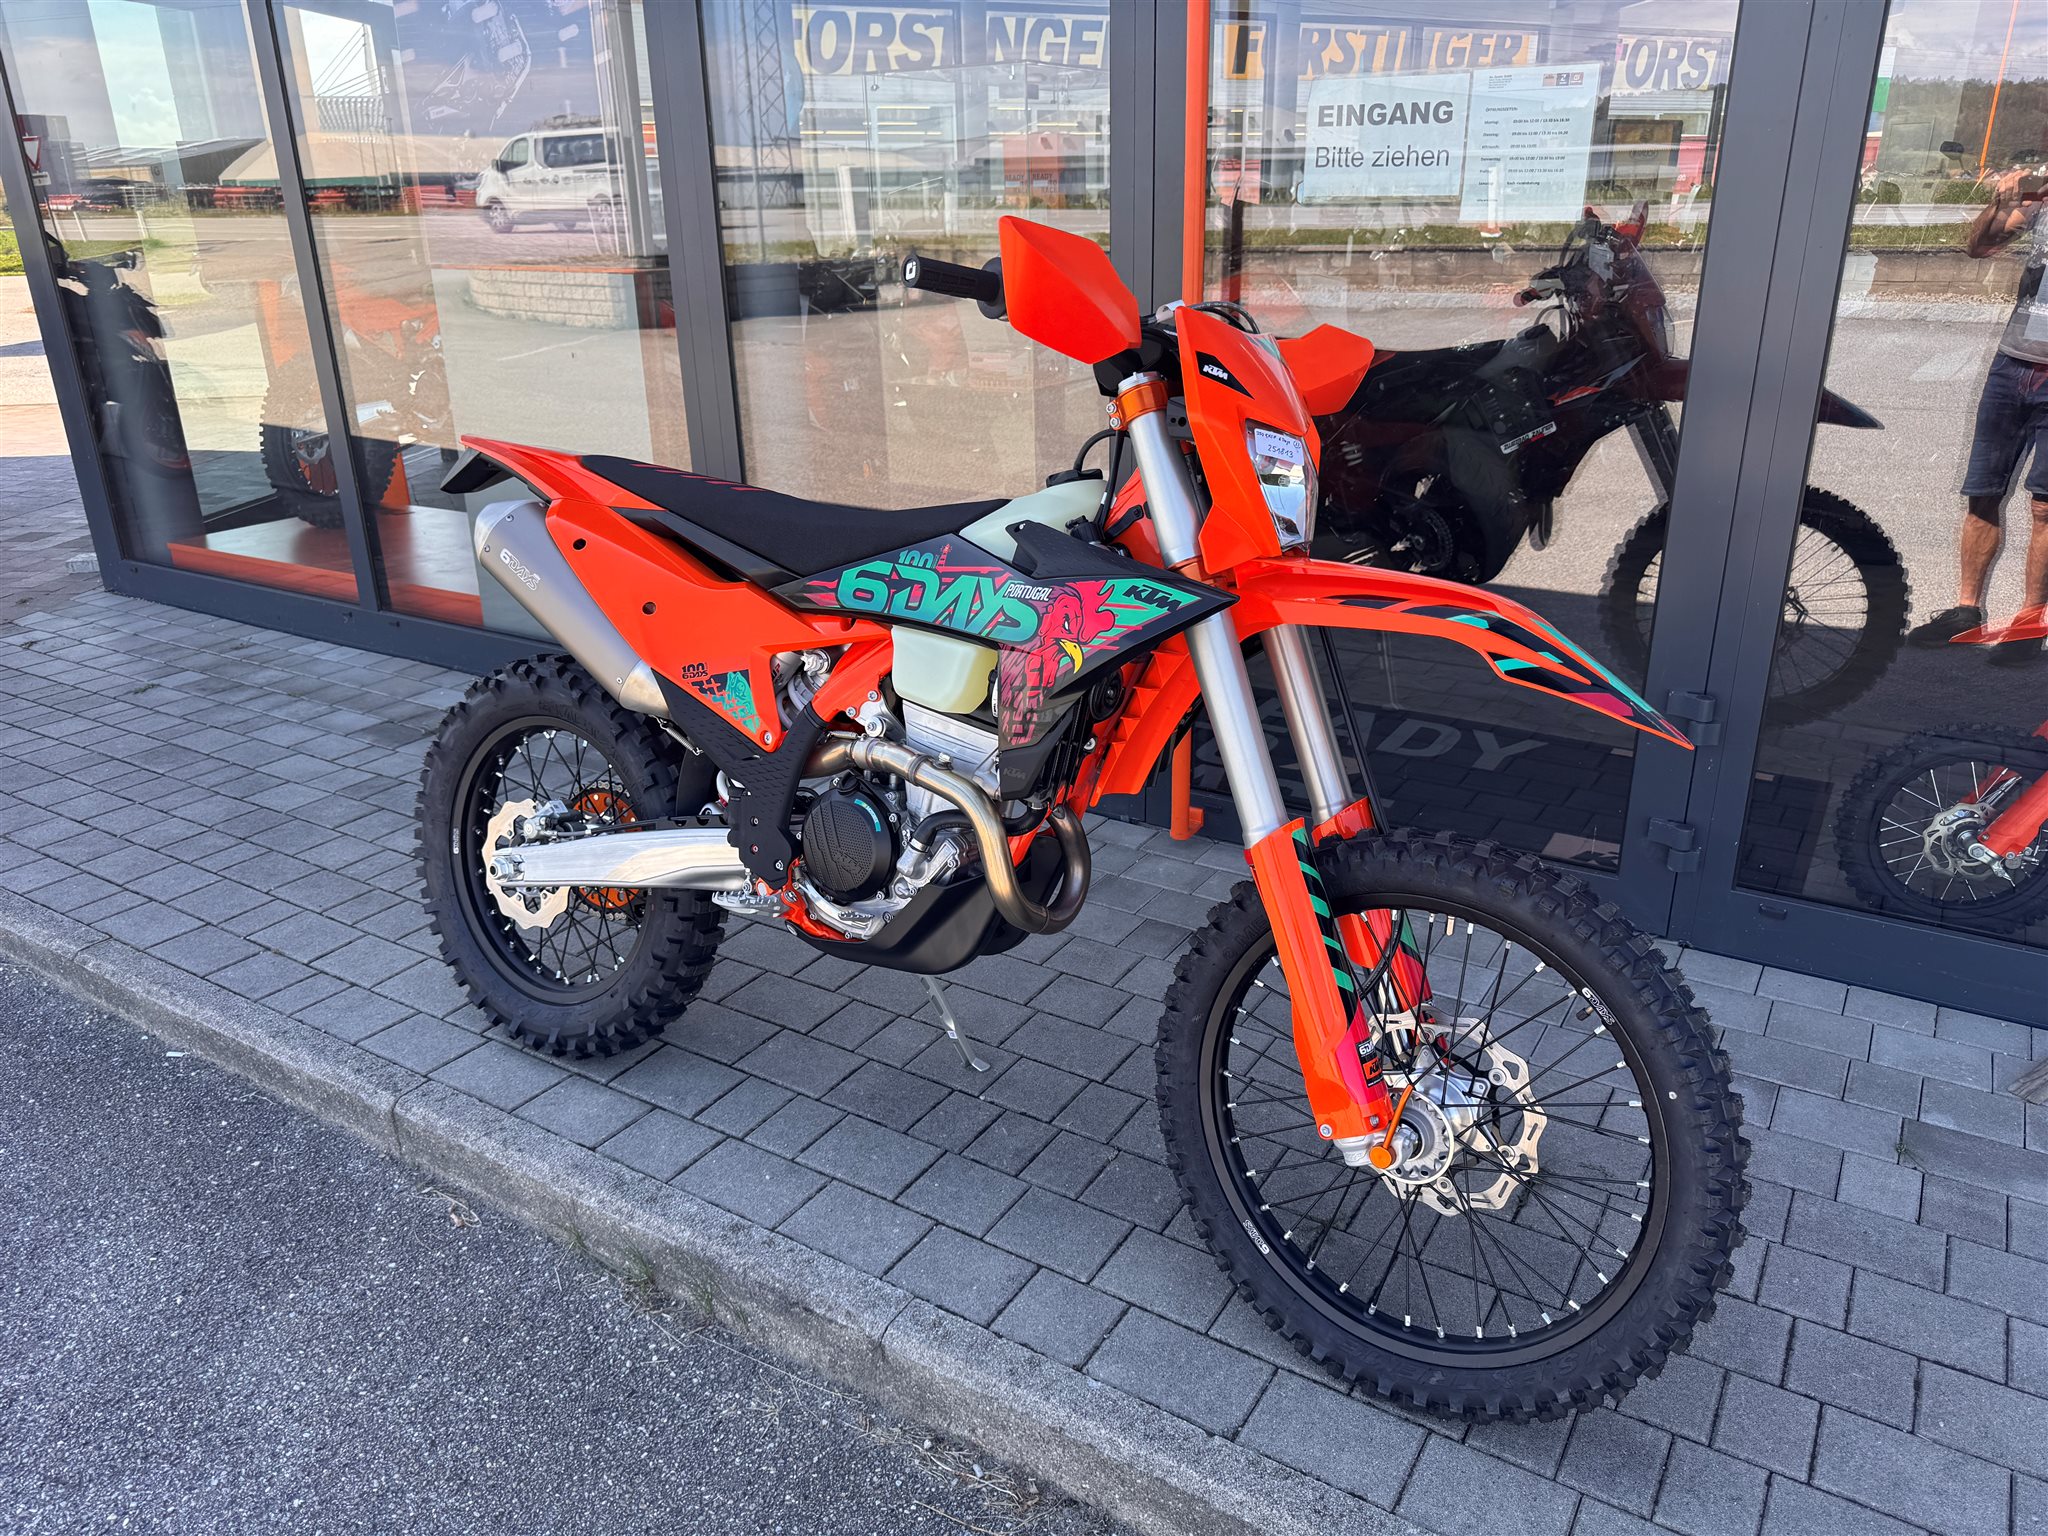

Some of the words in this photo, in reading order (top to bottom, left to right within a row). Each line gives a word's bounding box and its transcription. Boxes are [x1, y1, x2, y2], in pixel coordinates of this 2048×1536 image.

[1232, 24, 1522, 74] FRSTIGER
[1317, 100, 1454, 127] EINGANG
[1315, 146, 1364, 168] Bitte
[1371, 144, 1450, 168] ziehen
[1203, 364, 1228, 380] KTM
[500, 548, 540, 591] 6DAYS
[1003, 583, 1052, 602] PORTUGAL
[1123, 583, 1182, 612] KTM
[1003, 767, 1026, 780] KTM
